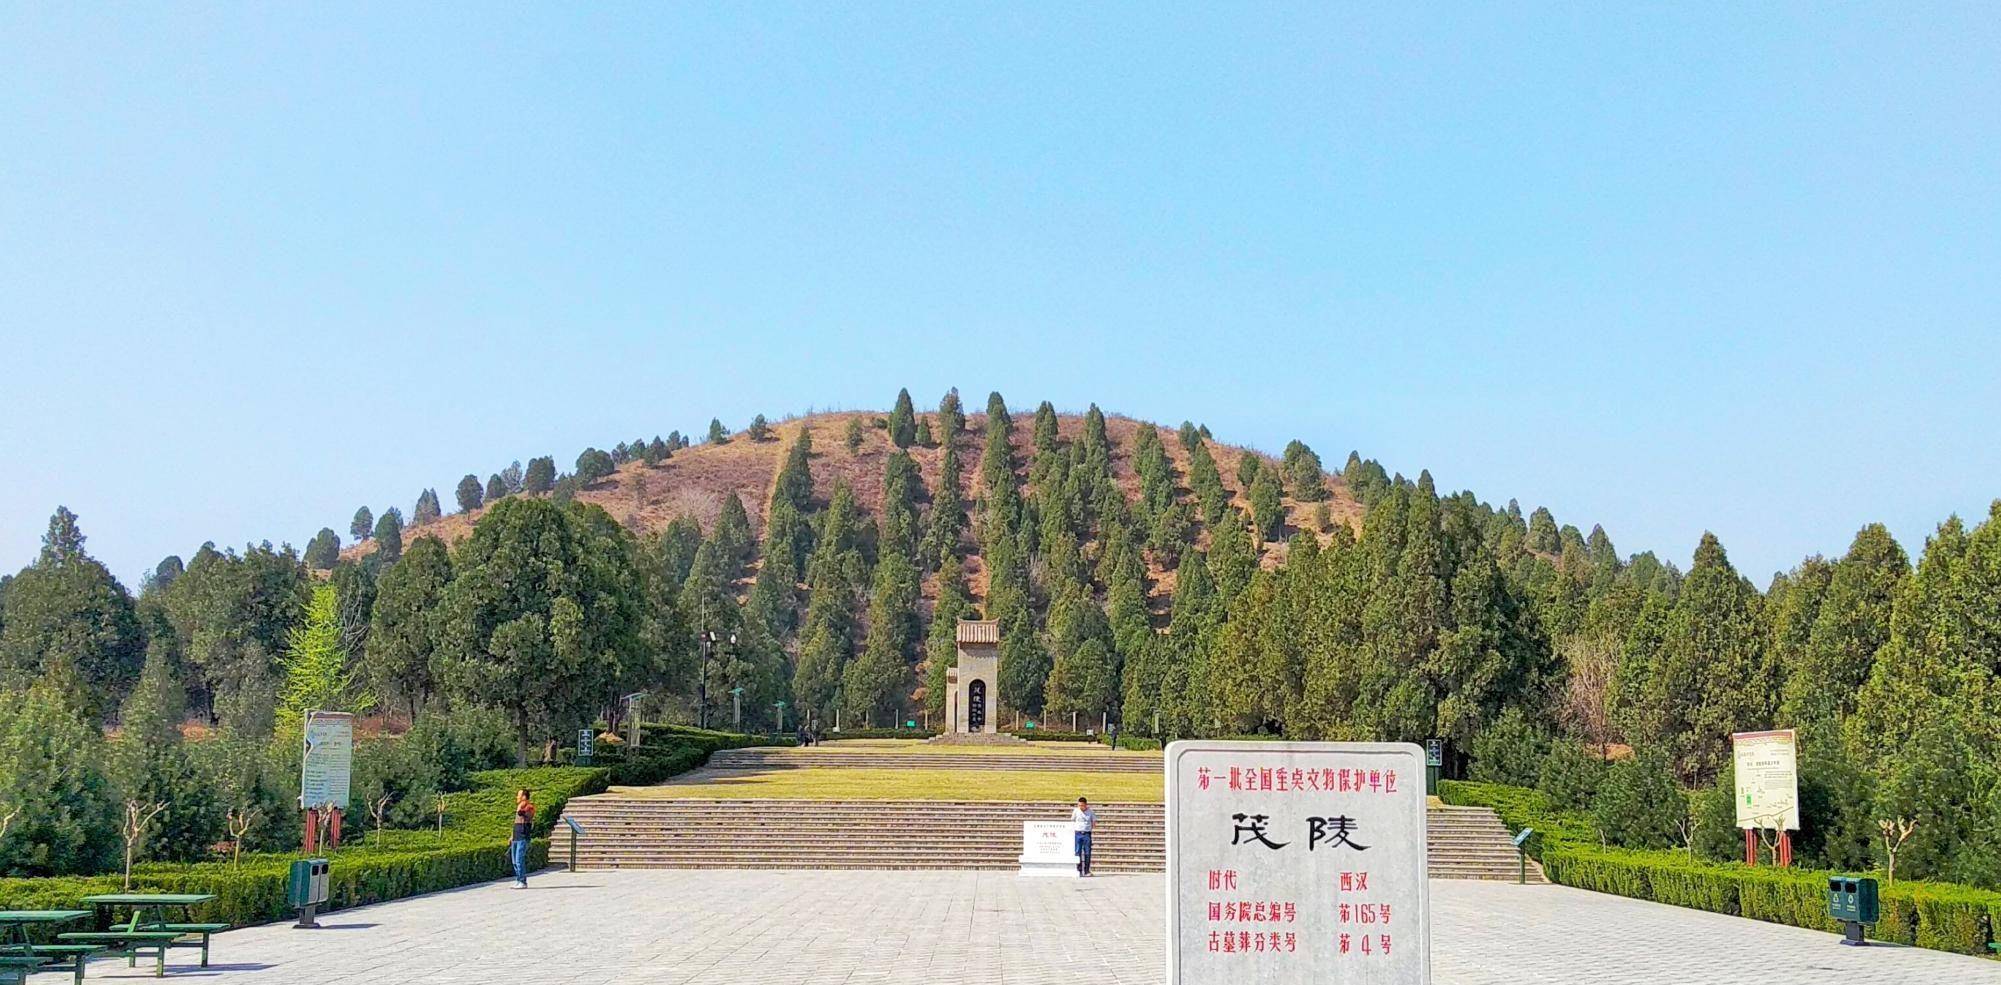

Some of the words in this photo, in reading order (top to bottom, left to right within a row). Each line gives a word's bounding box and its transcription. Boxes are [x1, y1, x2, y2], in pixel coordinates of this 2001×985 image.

[1197, 766, 1397, 793] 第一批全国重点文物保护单位
[1231, 812, 1372, 851] 茂陵
[1208, 869, 1237, 891] 时代
[1339, 871, 1368, 892] 西汉
[1208, 901, 1296, 923] 国务院总编号
[1339, 903, 1392, 924] 第165号
